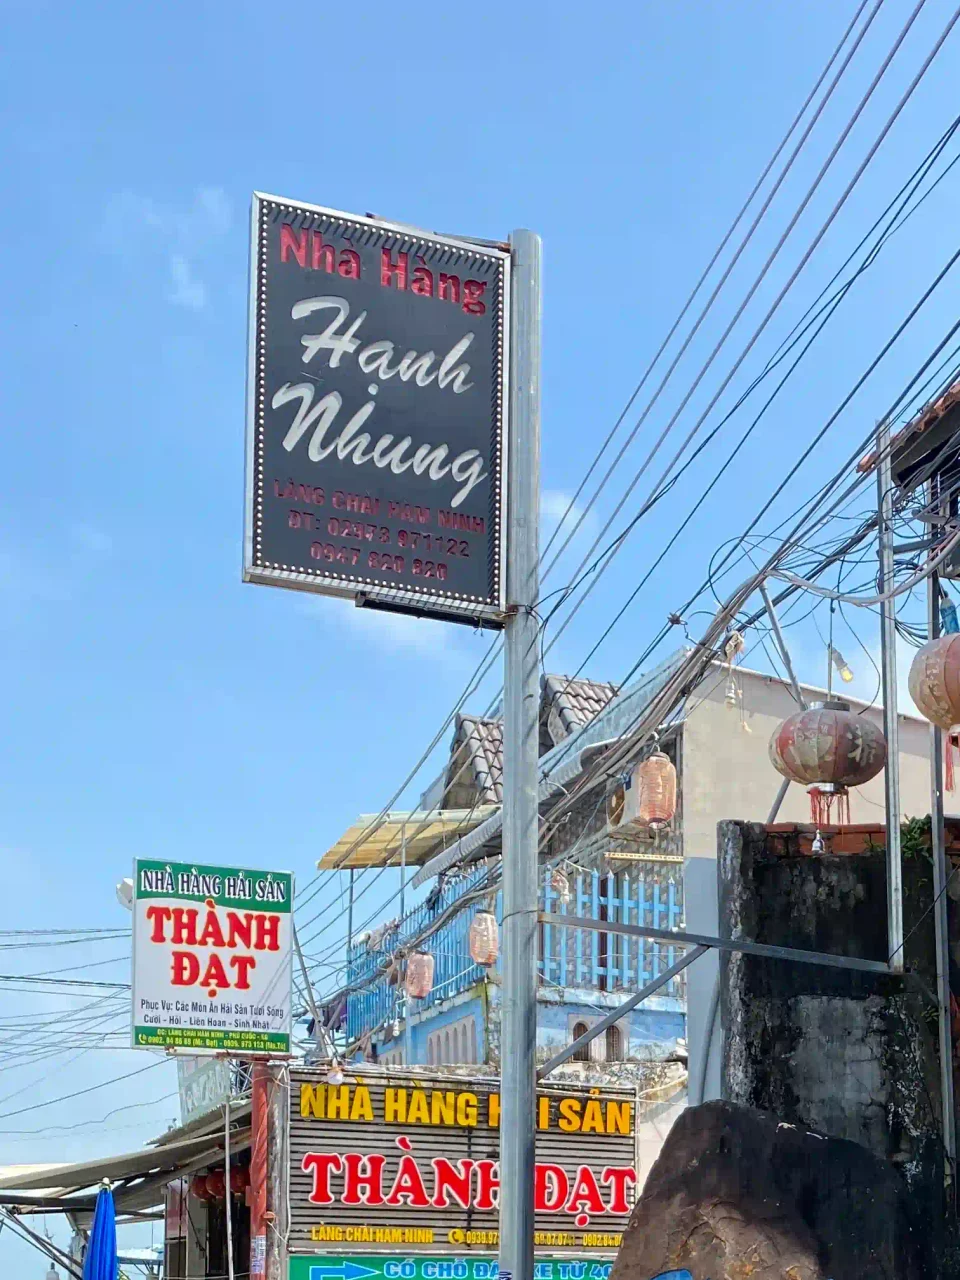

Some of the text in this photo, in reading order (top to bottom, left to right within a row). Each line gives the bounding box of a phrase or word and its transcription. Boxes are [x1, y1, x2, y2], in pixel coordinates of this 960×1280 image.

[280, 222, 488, 316] Nhà Hàng
[272, 382, 489, 508] Nhung
[437, 509, 486, 534] NINH
[141, 865, 286, 902] NHÀ HÀNG HẢI SẢN
[146, 898, 281, 951] THÀNH
[170, 950, 256, 998] ĐẠT
[140, 999, 159, 1012] Phục
[175, 1000, 189, 1012] Các
[191, 1001, 207, 1013] Món
[300, 1076, 631, 1135] NHÀ HÀNG HI SẢN
[301, 1135, 637, 1227] THÀNH ĐẠT
[311, 1221, 343, 1242] LÀNG
[402, 1229, 434, 1244] NINH
[466, 1230, 499, 1245] 0939.97
[384, 1258, 416, 1279] CÓ
[421, 1258, 469, 1279] CHỖ
[557, 1260, 587, 1280] TỪ
